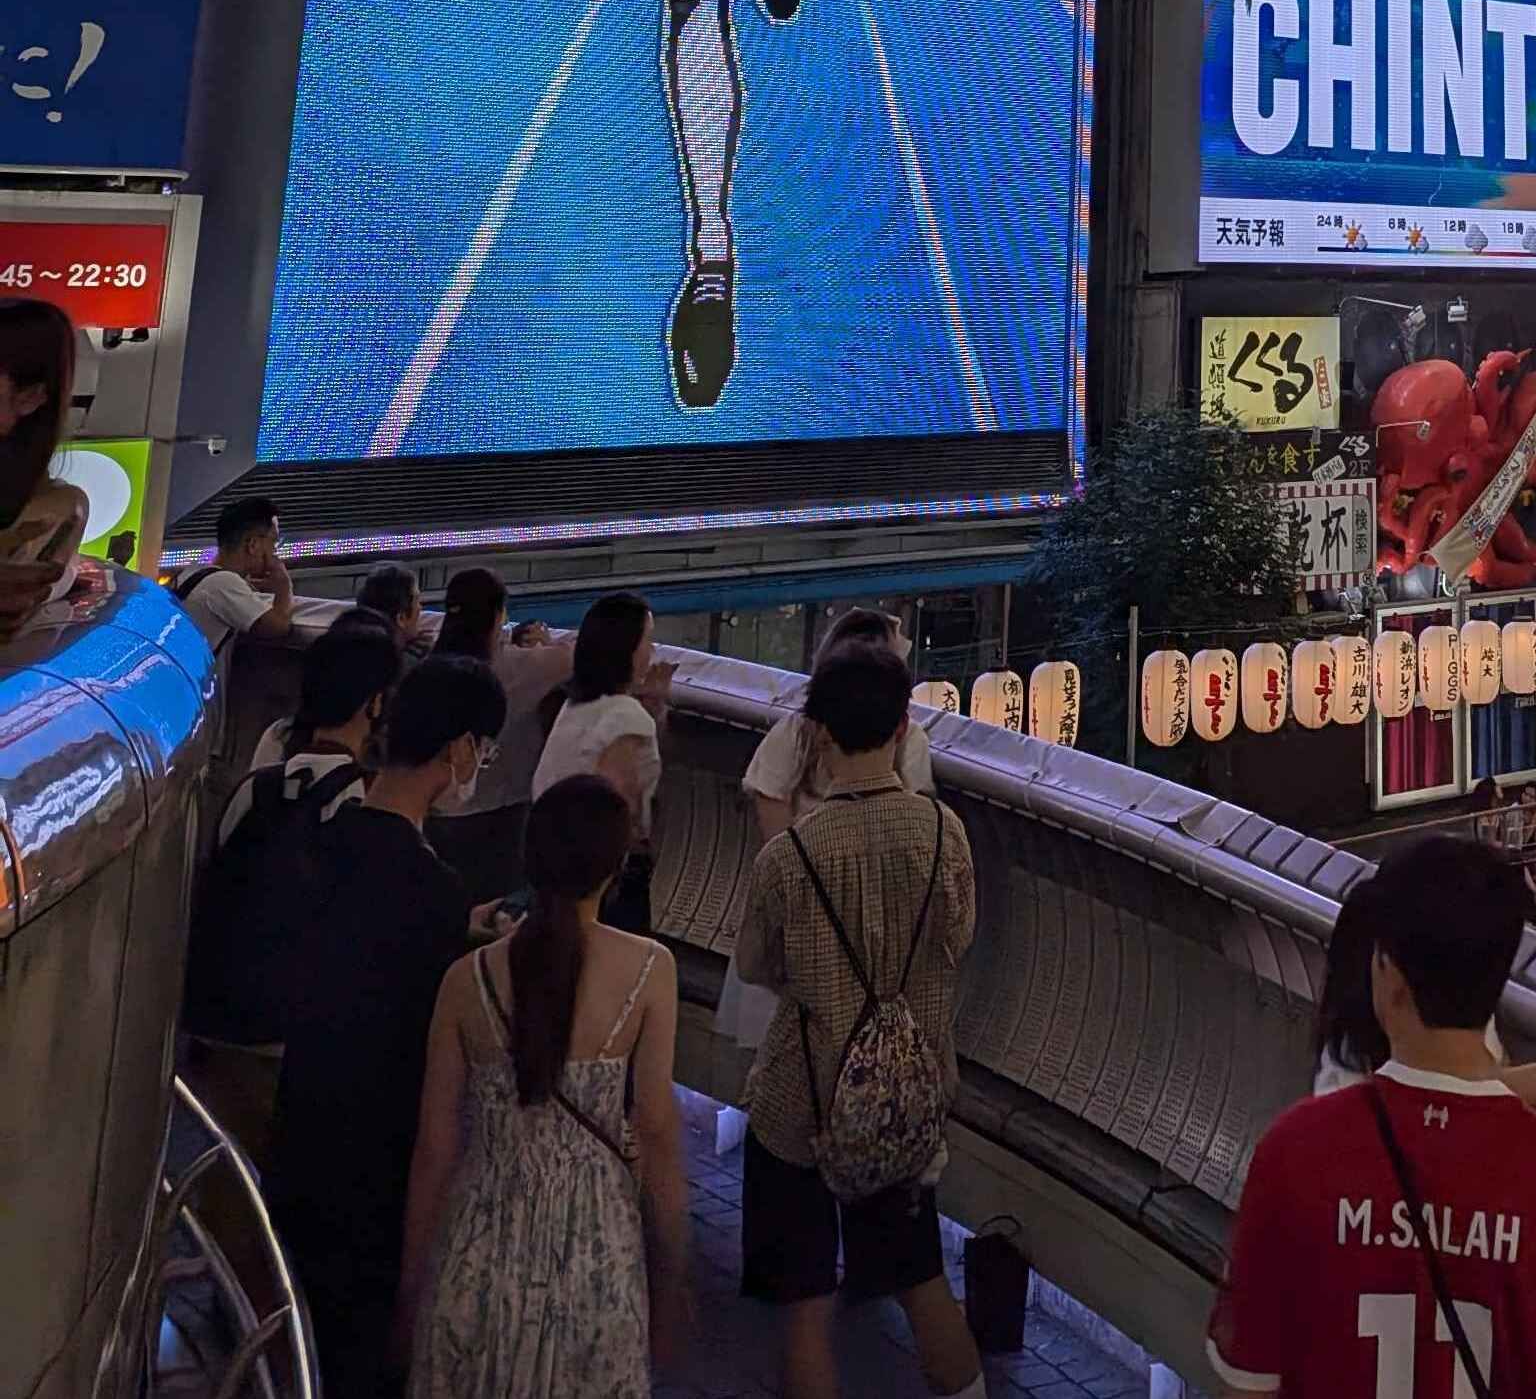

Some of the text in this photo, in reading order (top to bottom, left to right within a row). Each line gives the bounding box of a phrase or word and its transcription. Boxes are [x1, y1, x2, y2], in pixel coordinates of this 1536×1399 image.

[0, 22, 105, 123] こ!
[1216, 216, 1285, 248] 天気予報
[1227, 331, 1314, 414] くくる
[1349, 459, 1371, 478] 2F
[1350, 645, 1368, 715] 古川雄大
[1447, 633, 1459, 702] PIGGS
[1337, 1197, 1521, 1264] M.SALAH
[1357, 1293, 1493, 1399] 11
